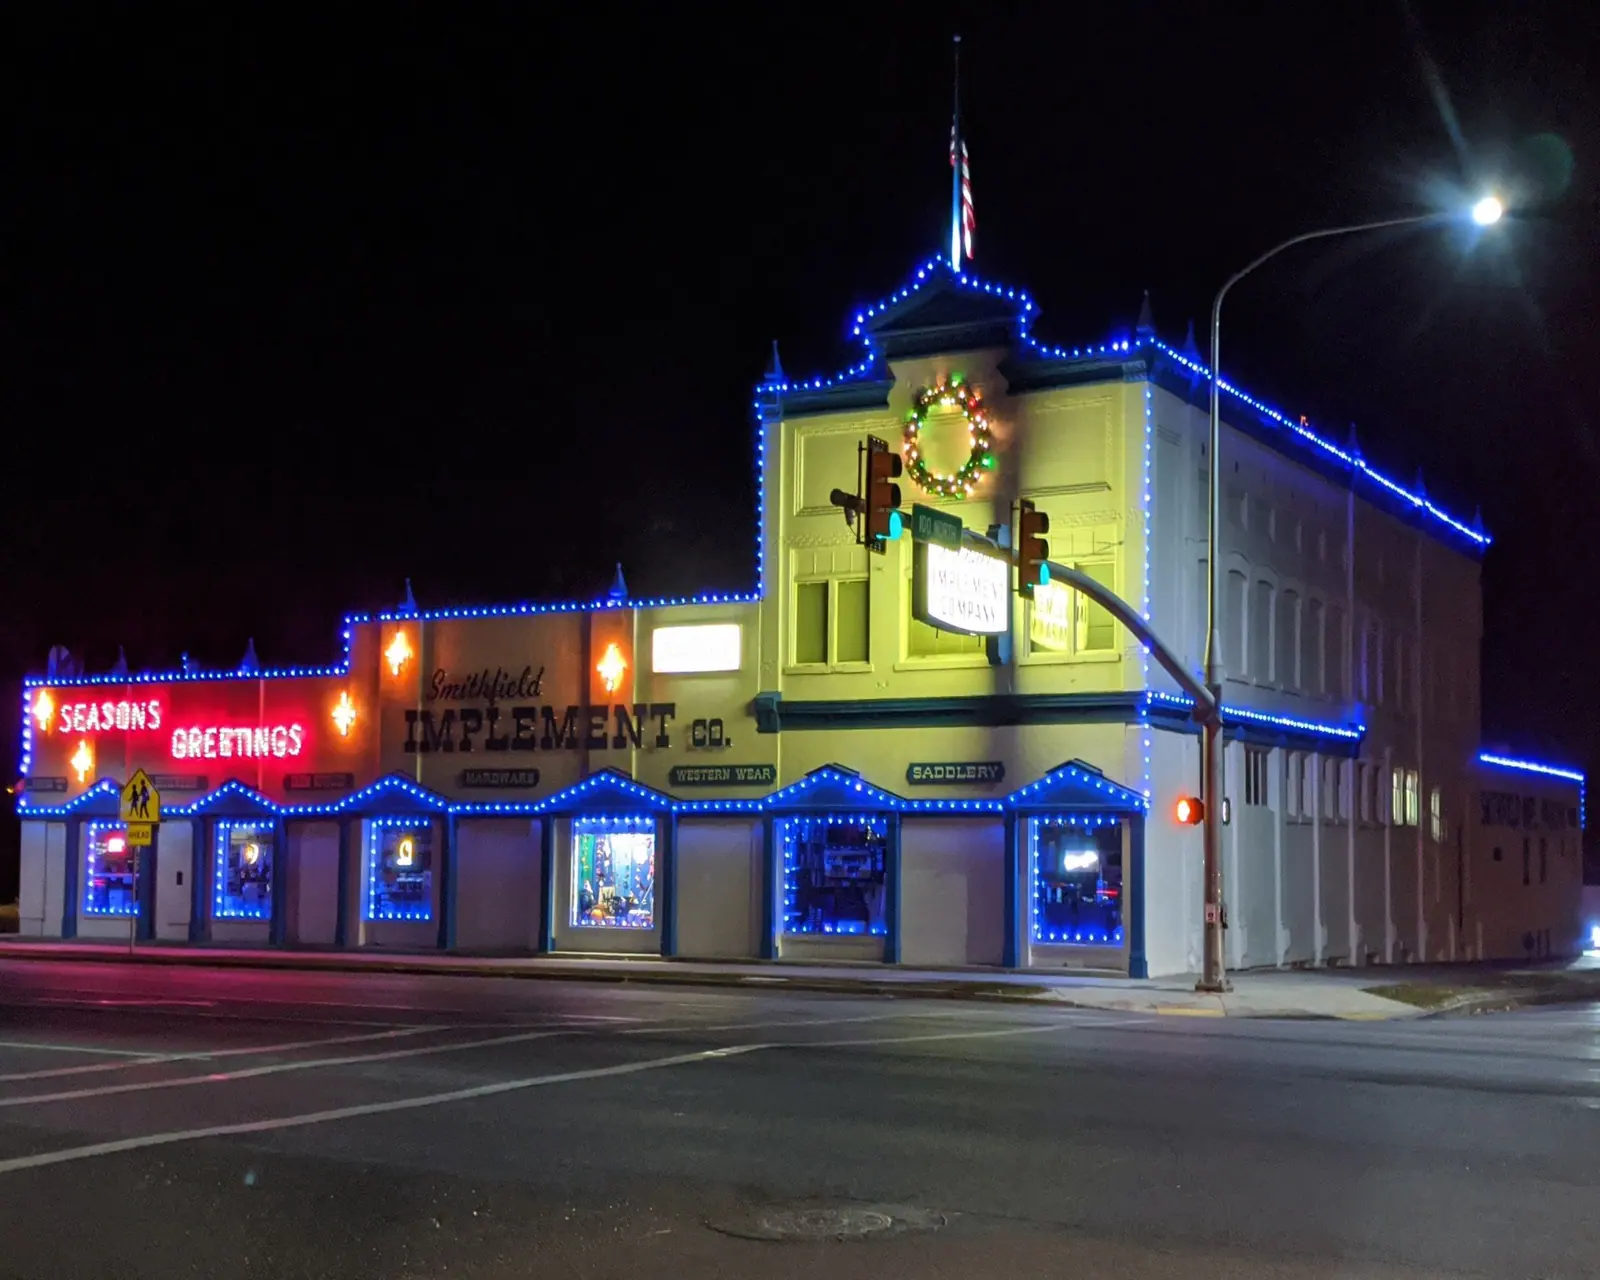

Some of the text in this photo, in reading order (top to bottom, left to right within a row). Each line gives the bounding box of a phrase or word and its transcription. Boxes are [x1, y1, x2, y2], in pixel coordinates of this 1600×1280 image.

[918, 514, 957, 545] 100 NORTH
[931, 567, 1004, 602] IMPLEMENT
[940, 594, 997, 623] COMPANY
[425, 665, 544, 707] Smithfield
[58, 700, 162, 734] SEASONS
[403, 702, 734, 754] IMPLEMENT CO.
[170, 723, 305, 760] GREETINGS
[465, 771, 536, 785] HARDWARE
[675, 766, 772, 782] WESTERN WEAR
[911, 764, 999, 780] SADDLERY
[128, 830, 150, 841] AHEAD
